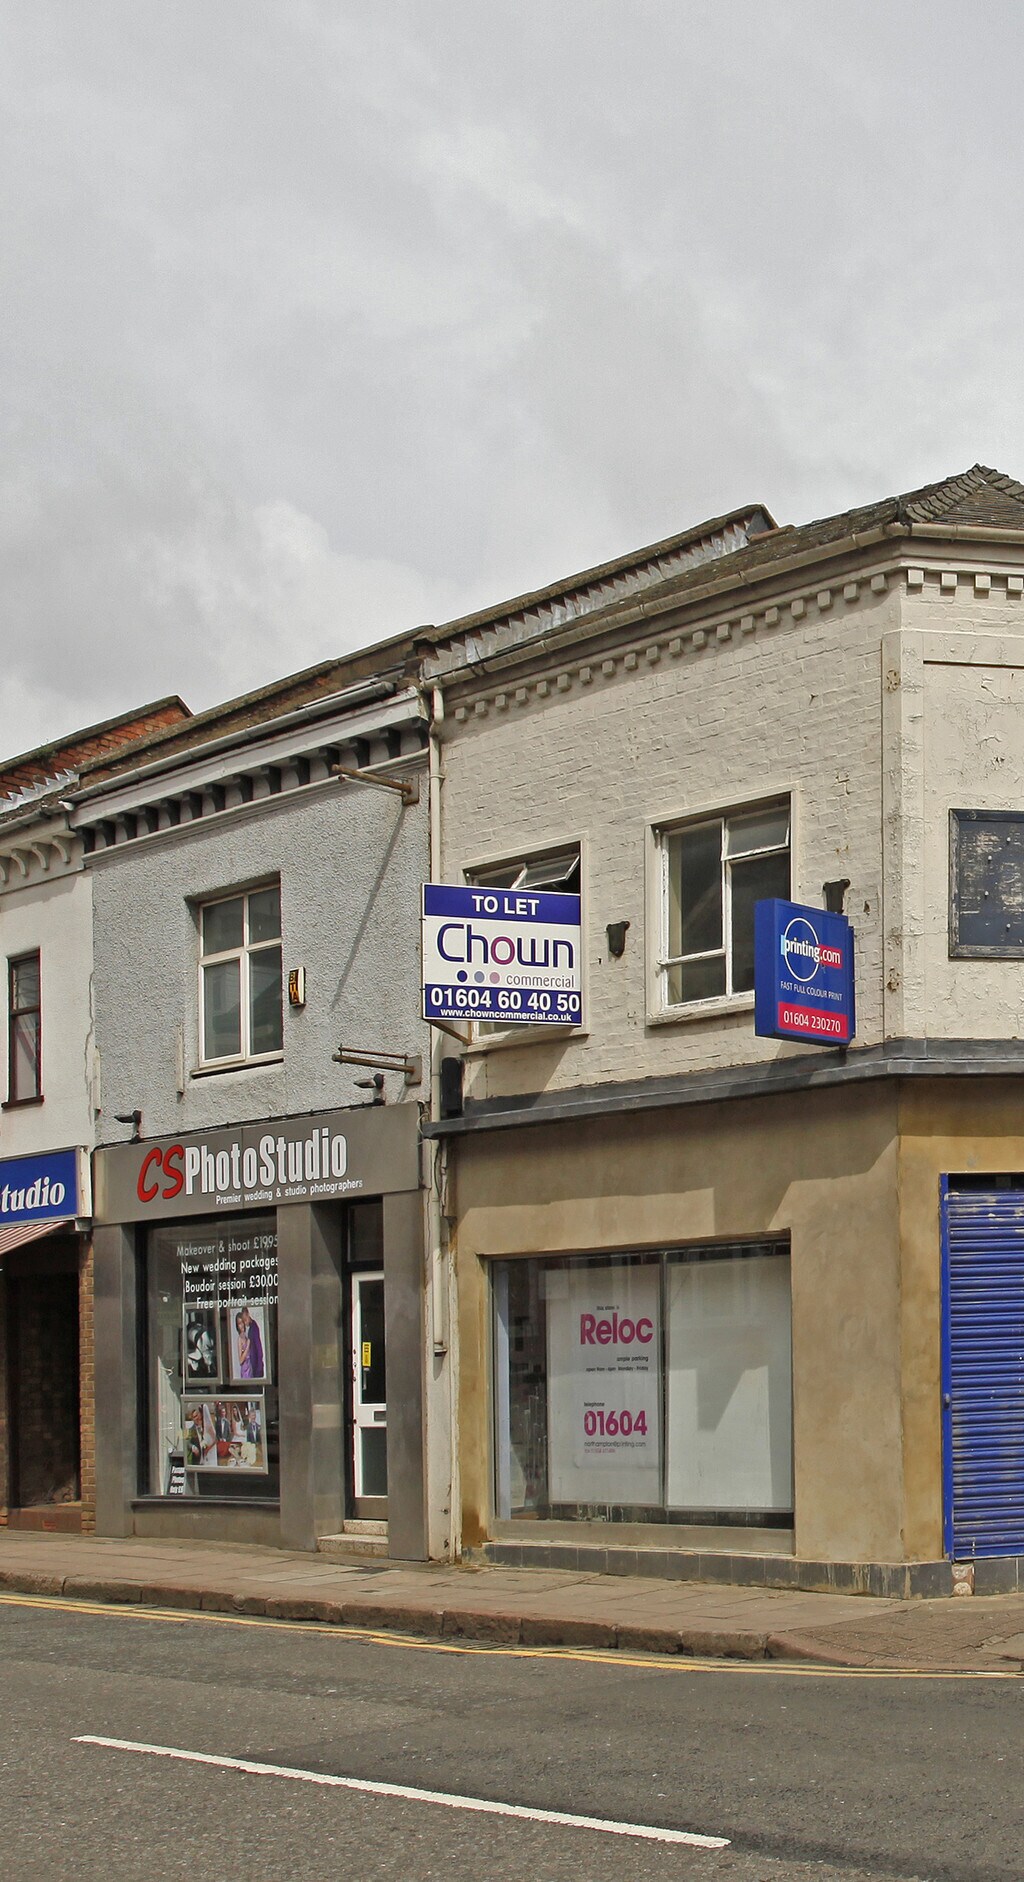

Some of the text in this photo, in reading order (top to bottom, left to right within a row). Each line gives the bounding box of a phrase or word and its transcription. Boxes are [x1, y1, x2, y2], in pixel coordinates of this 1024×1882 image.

[472, 895, 540, 916] TO LET
[437, 923, 574, 969] Chown
[784, 937, 841, 964] printing.com
[506, 974, 575, 988] commercial
[780, 980, 843, 1001] FAST FULL COLOUR PRINT
[430, 987, 580, 1012] 01604 60 40 50
[440, 1008, 572, 1022] www.chowncommercial.co.uk
[783, 1010, 841, 1033] 01604 230270
[0, 1176, 66, 1214] tudio
[216, 1179, 363, 1205] Premier wedding & studio photographers
[177, 1243, 215, 1257] Makeover
[219, 1240, 225, 1252] &
[228, 1238, 250, 1252] shoot
[181, 1262, 199, 1274] New
[203, 1258, 236, 1273] wedding
[185, 1279, 215, 1293] Boudoir
[218, 1278, 246, 1291] session
[196, 1297, 214, 1309] Free
[218, 1295, 247, 1308] portrait
[580, 1312, 653, 1345] Reloc
[584, 1410, 648, 1436] 01604
